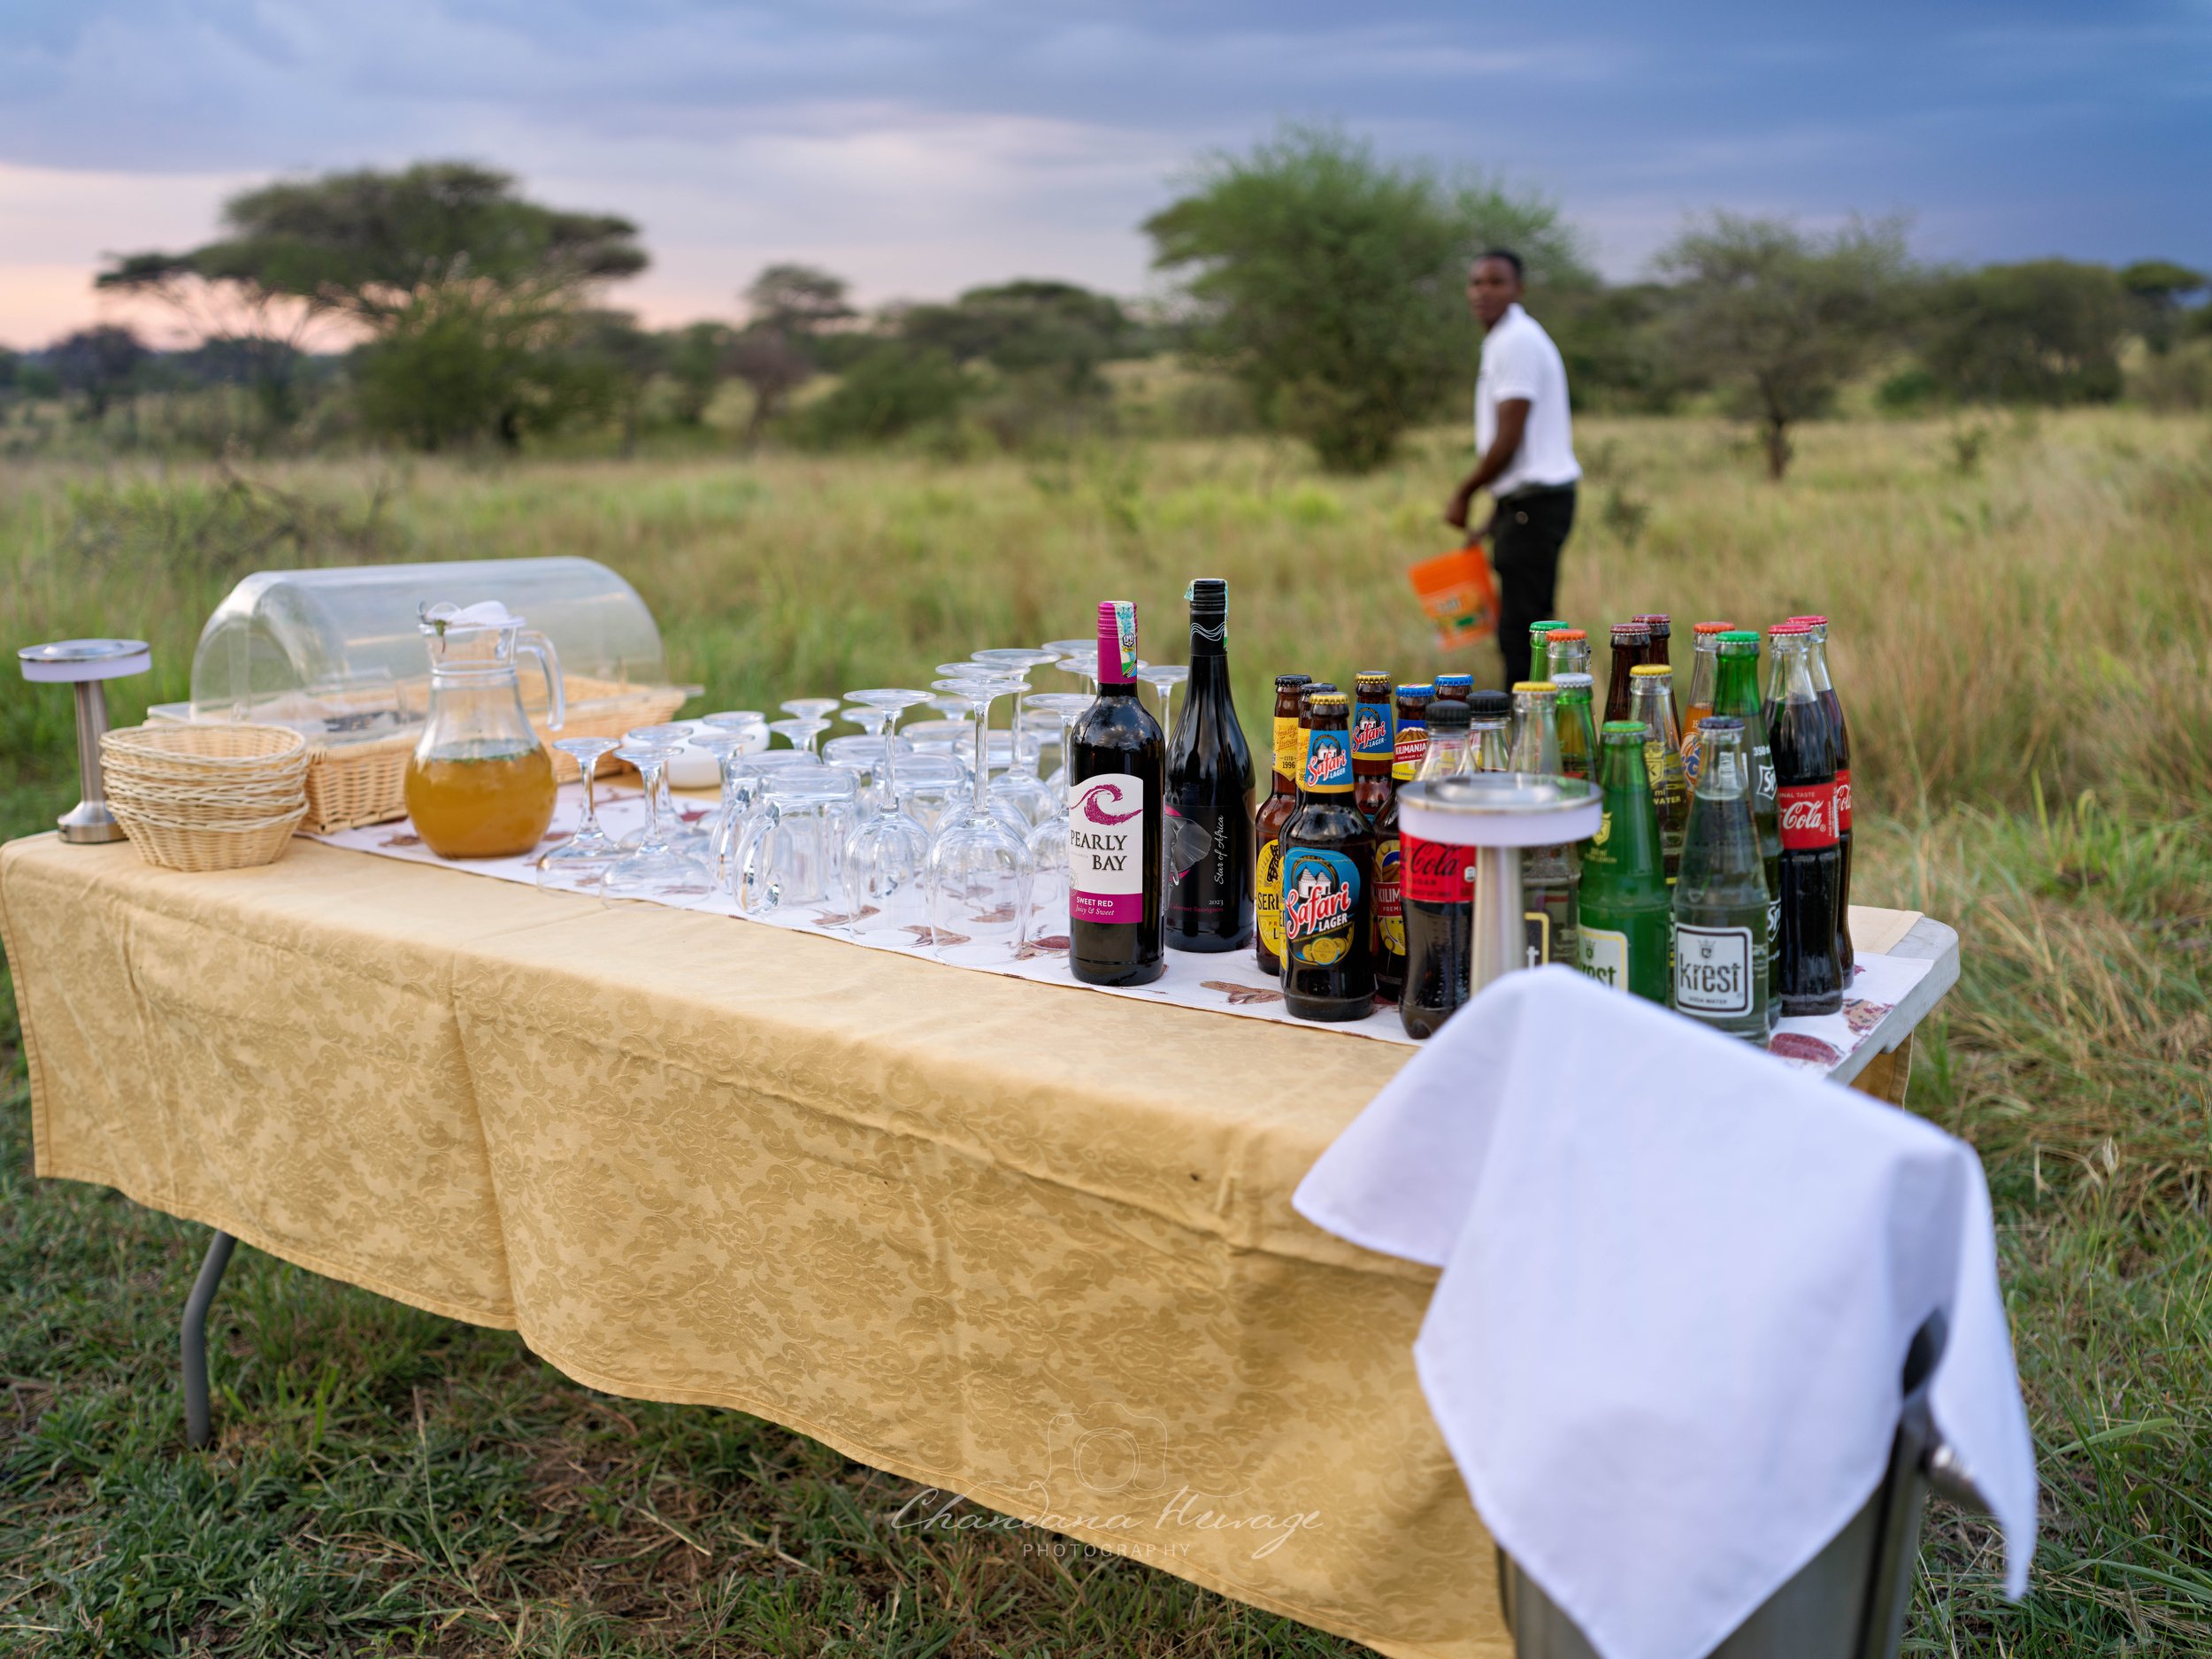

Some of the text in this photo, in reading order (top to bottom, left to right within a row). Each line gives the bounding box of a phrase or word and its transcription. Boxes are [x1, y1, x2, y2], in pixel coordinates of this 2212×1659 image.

[1352, 721, 1386, 754] Safari
[1370, 738, 1385, 748] LAGER
[1395, 742, 1426, 755] KILIMANJA
[1308, 749, 1347, 787] Safari
[1330, 767, 1346, 779] LAGER
[1781, 800, 1824, 830] Cola
[1071, 829, 1127, 851] PEARLY
[1214, 815, 1227, 885] Star of Africa
[1092, 854, 1127, 871] BAY
[1076, 896, 1114, 908] SWEET RED
[1379, 887, 1401, 902] KILIM
[1076, 904, 1087, 915] Juicy
[1286, 881, 1352, 940] Safari
[1318, 913, 1348, 932] LAGER
[1680, 953, 1741, 993] krest
